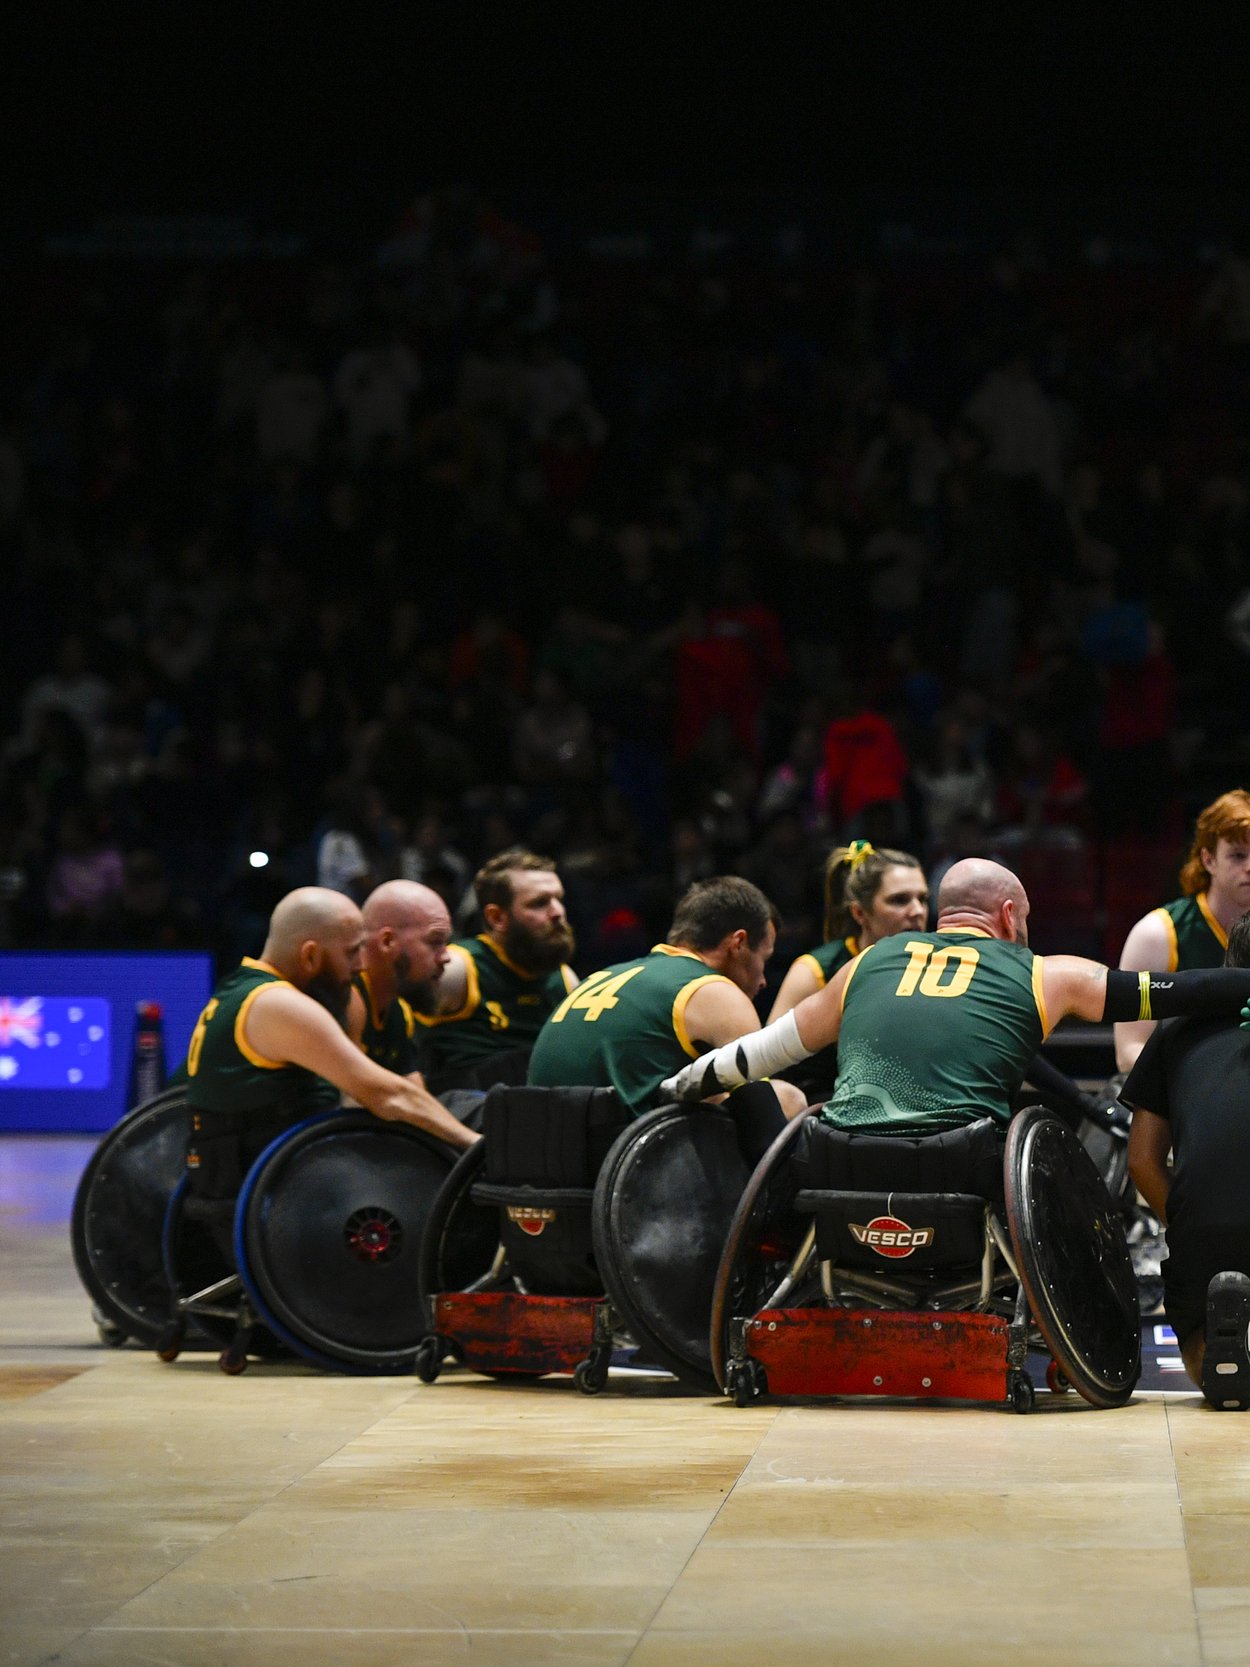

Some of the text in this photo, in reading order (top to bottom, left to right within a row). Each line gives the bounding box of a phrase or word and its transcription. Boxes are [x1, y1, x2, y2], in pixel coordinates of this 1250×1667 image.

[552, 966, 645, 1023] 14
[895, 942, 979, 997] 10
[853, 1228, 928, 1246] VESCO
